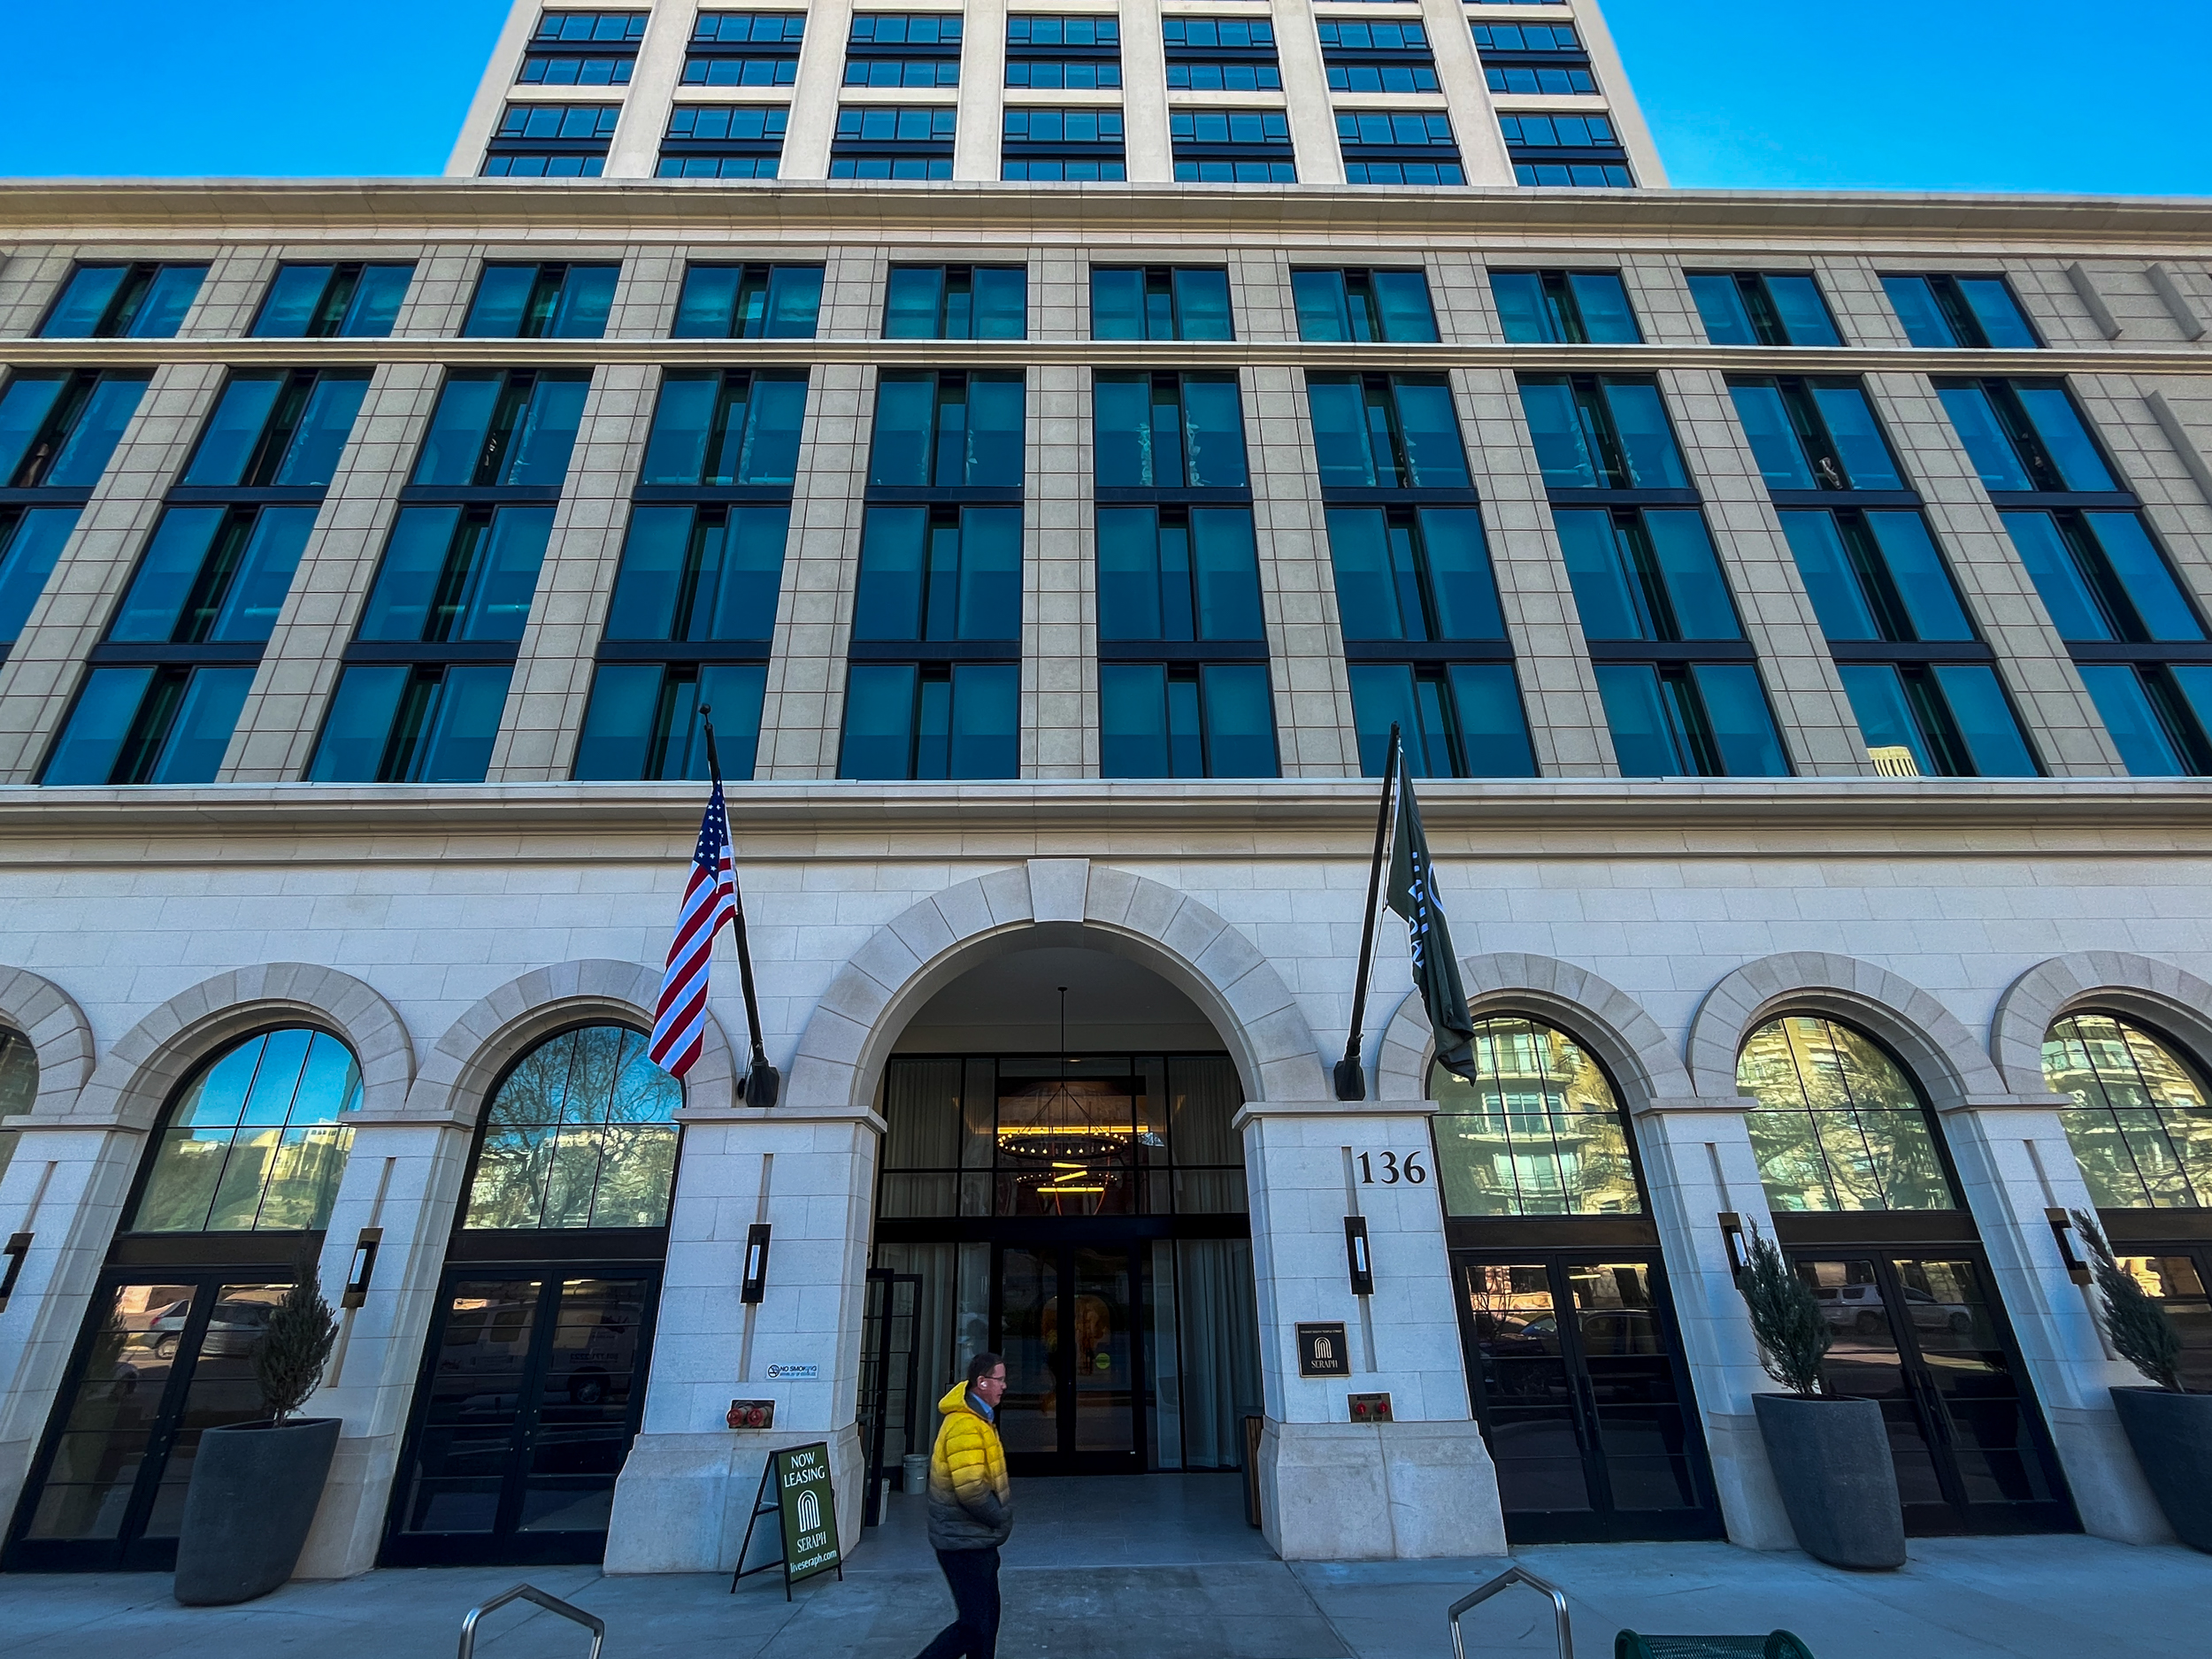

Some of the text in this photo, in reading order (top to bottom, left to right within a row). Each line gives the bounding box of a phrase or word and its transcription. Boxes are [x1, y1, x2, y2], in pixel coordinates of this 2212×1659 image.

[1356, 1150, 1427, 1184] 136
[1310, 1359, 1339, 1369] SERAPH
[791, 1451, 815, 1469] NOW
[784, 1465, 826, 1488] LEASING
[796, 1531, 827, 1553] SERAPH
[790, 1549, 837, 1573] liveseraph.com
